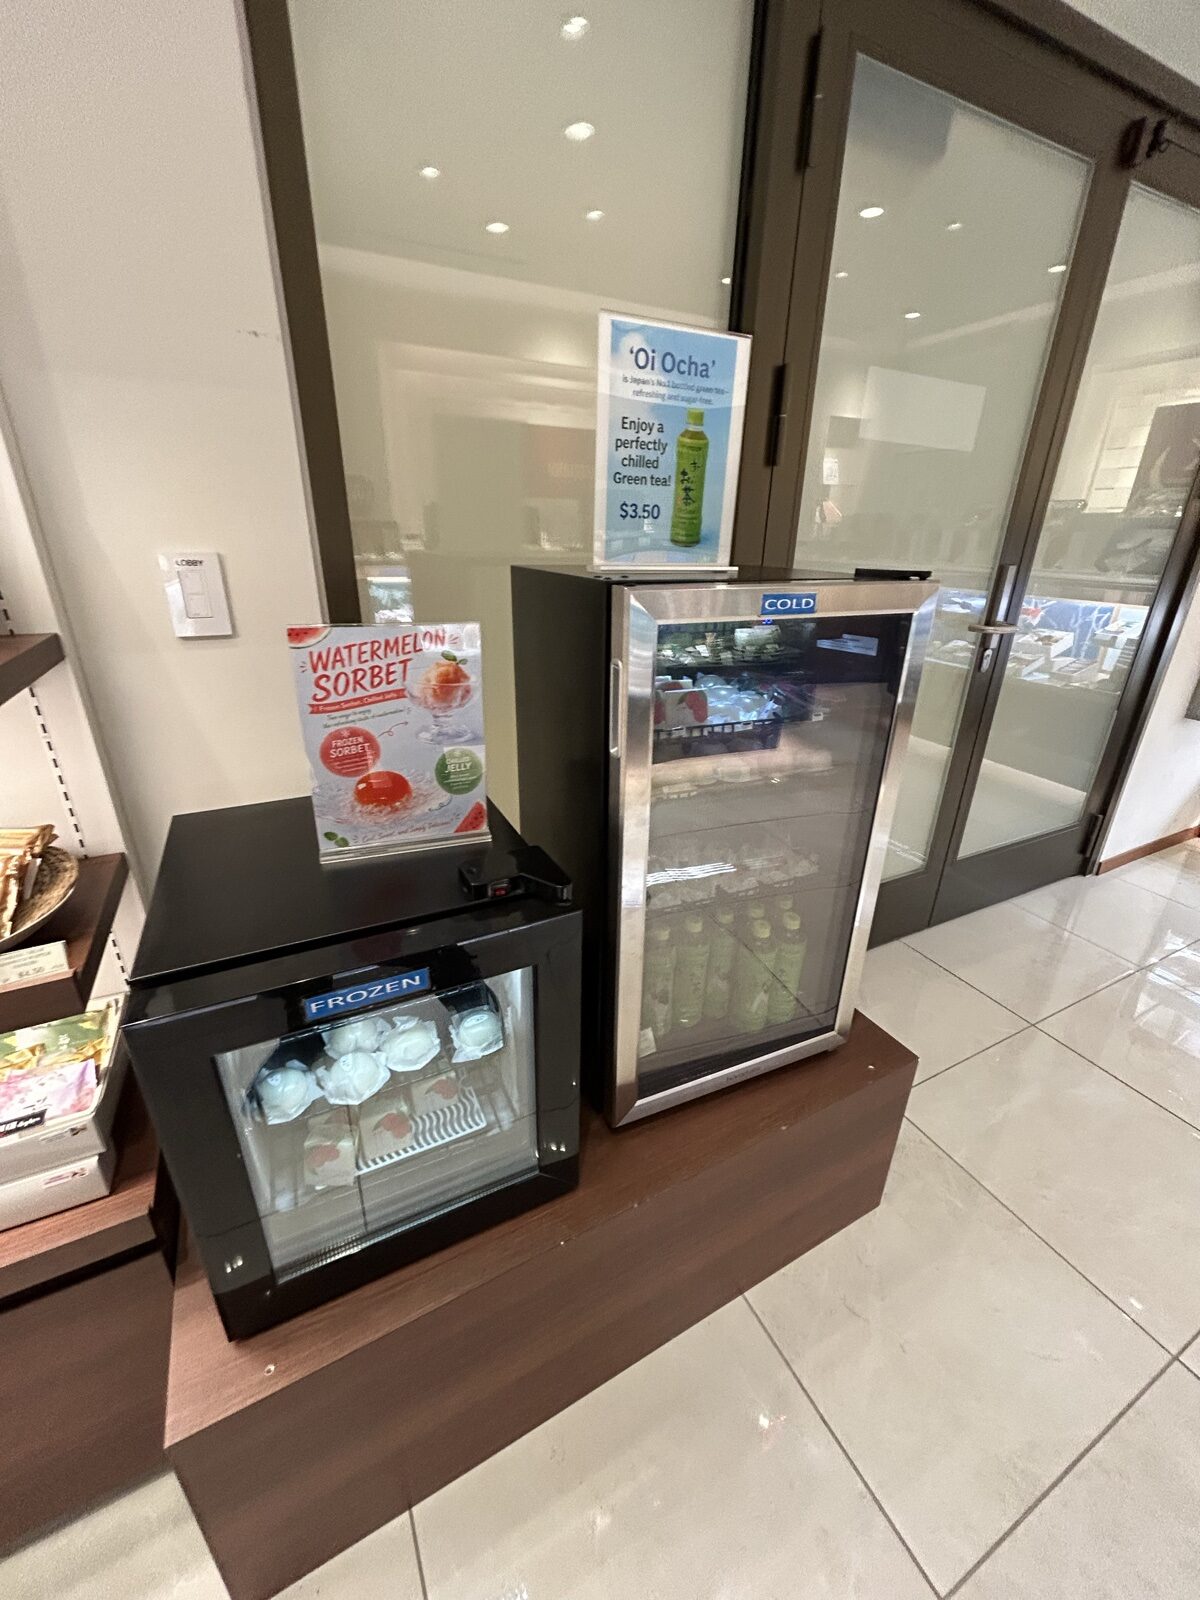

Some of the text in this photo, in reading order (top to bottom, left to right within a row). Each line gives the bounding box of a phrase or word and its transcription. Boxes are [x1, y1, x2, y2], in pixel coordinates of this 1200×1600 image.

[621, 416, 665, 436] Enjoy a
[615, 436, 668, 455] perfectly
[621, 454, 660, 469] chilled
[613, 471, 672, 487] Green tea!
[619, 501, 661, 520] $3.50
[175, 559, 203, 567] LOBBY
[764, 598, 815, 610] COLD
[308, 628, 446, 674] WATERMELON
[311, 657, 414, 703] SORBET
[329, 742, 371, 759] SORBET
[331, 735, 365, 749] FROZEN
[444, 761, 473, 773] JELLY
[310, 975, 421, 1014] FROZEN
